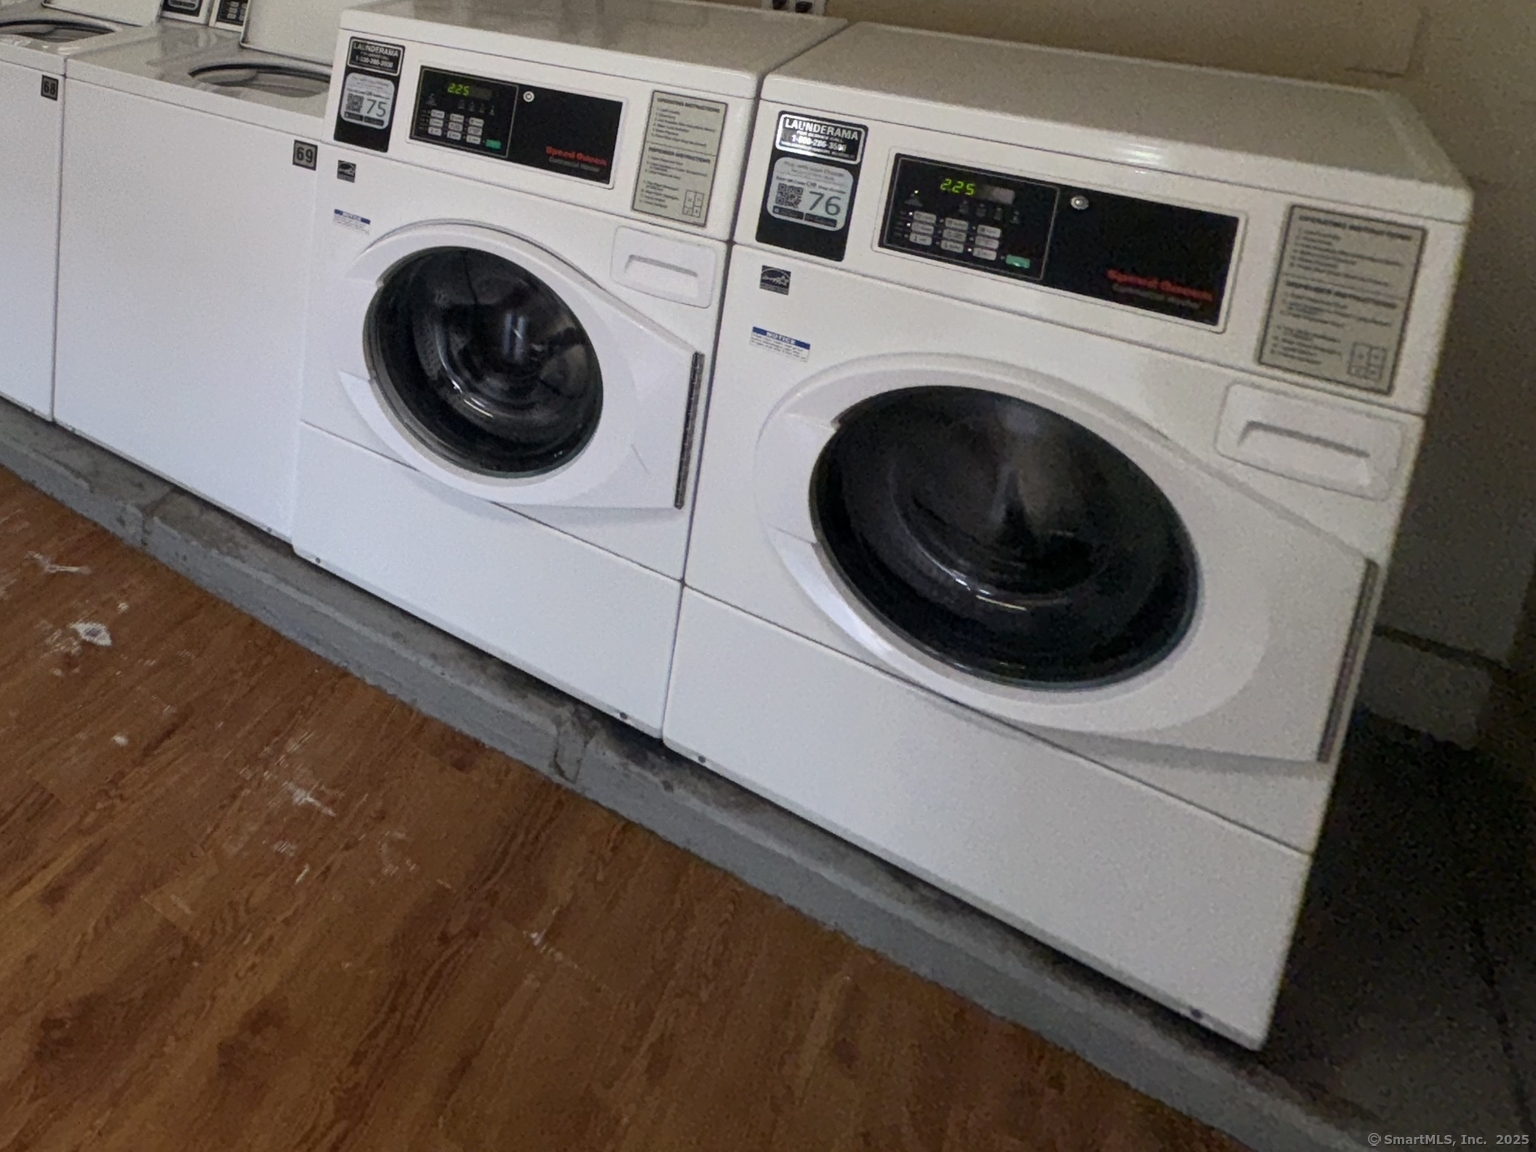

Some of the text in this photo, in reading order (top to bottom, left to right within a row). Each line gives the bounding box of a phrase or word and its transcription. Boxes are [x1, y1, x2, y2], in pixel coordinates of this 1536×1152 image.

[353, 42, 399, 57] LAUNDERAMA
[44, 80, 56, 95] 68
[366, 98, 387, 117] 75
[785, 118, 858, 141] LAUNDERAMA
[296, 146, 313, 164] 69
[809, 190, 841, 216] 76
[766, 332, 796, 344] NOTICE
